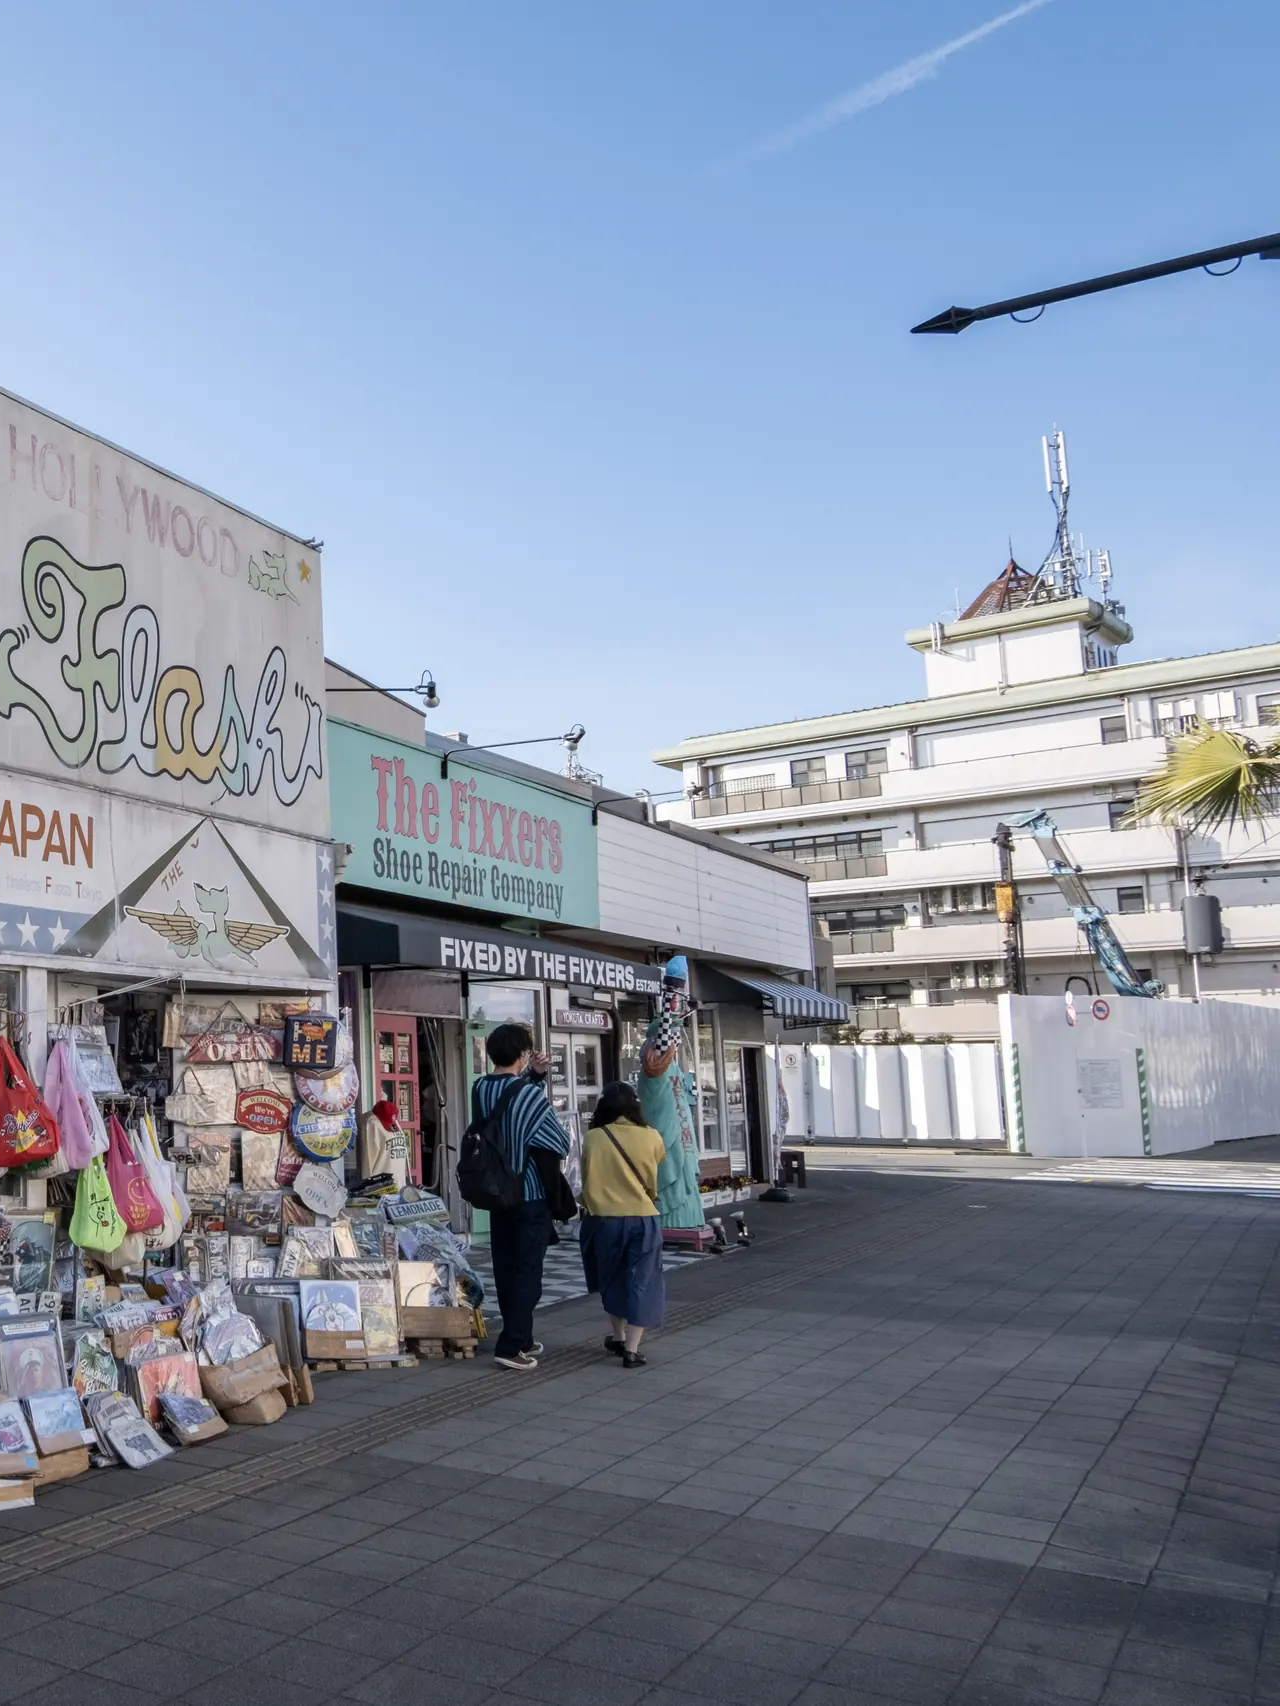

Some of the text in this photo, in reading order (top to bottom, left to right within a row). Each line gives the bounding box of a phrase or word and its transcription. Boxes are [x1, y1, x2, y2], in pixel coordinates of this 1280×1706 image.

[370, 753, 564, 875] The Fixxers
[161, 860, 184, 893] THE
[372, 837, 565, 920] Shoe Repair Company
[440, 936, 502, 973] FIXED
[504, 945, 529, 976] BY
[531, 950, 567, 982] THE
[569, 955, 636, 991] FIXXERS
[584, 1012, 605, 1026] CRAFTS
[250, 1096, 281, 1108] WELCOME
[300, 1086, 344, 1112] MOTOR
[249, 1113, 279, 1126] OPEN
[254, 1105, 276, 1115] We're
[306, 1132, 350, 1150] SERVICE
[312, 1171, 338, 1193] WELCOME
[391, 1199, 444, 1219] LEMONADE
